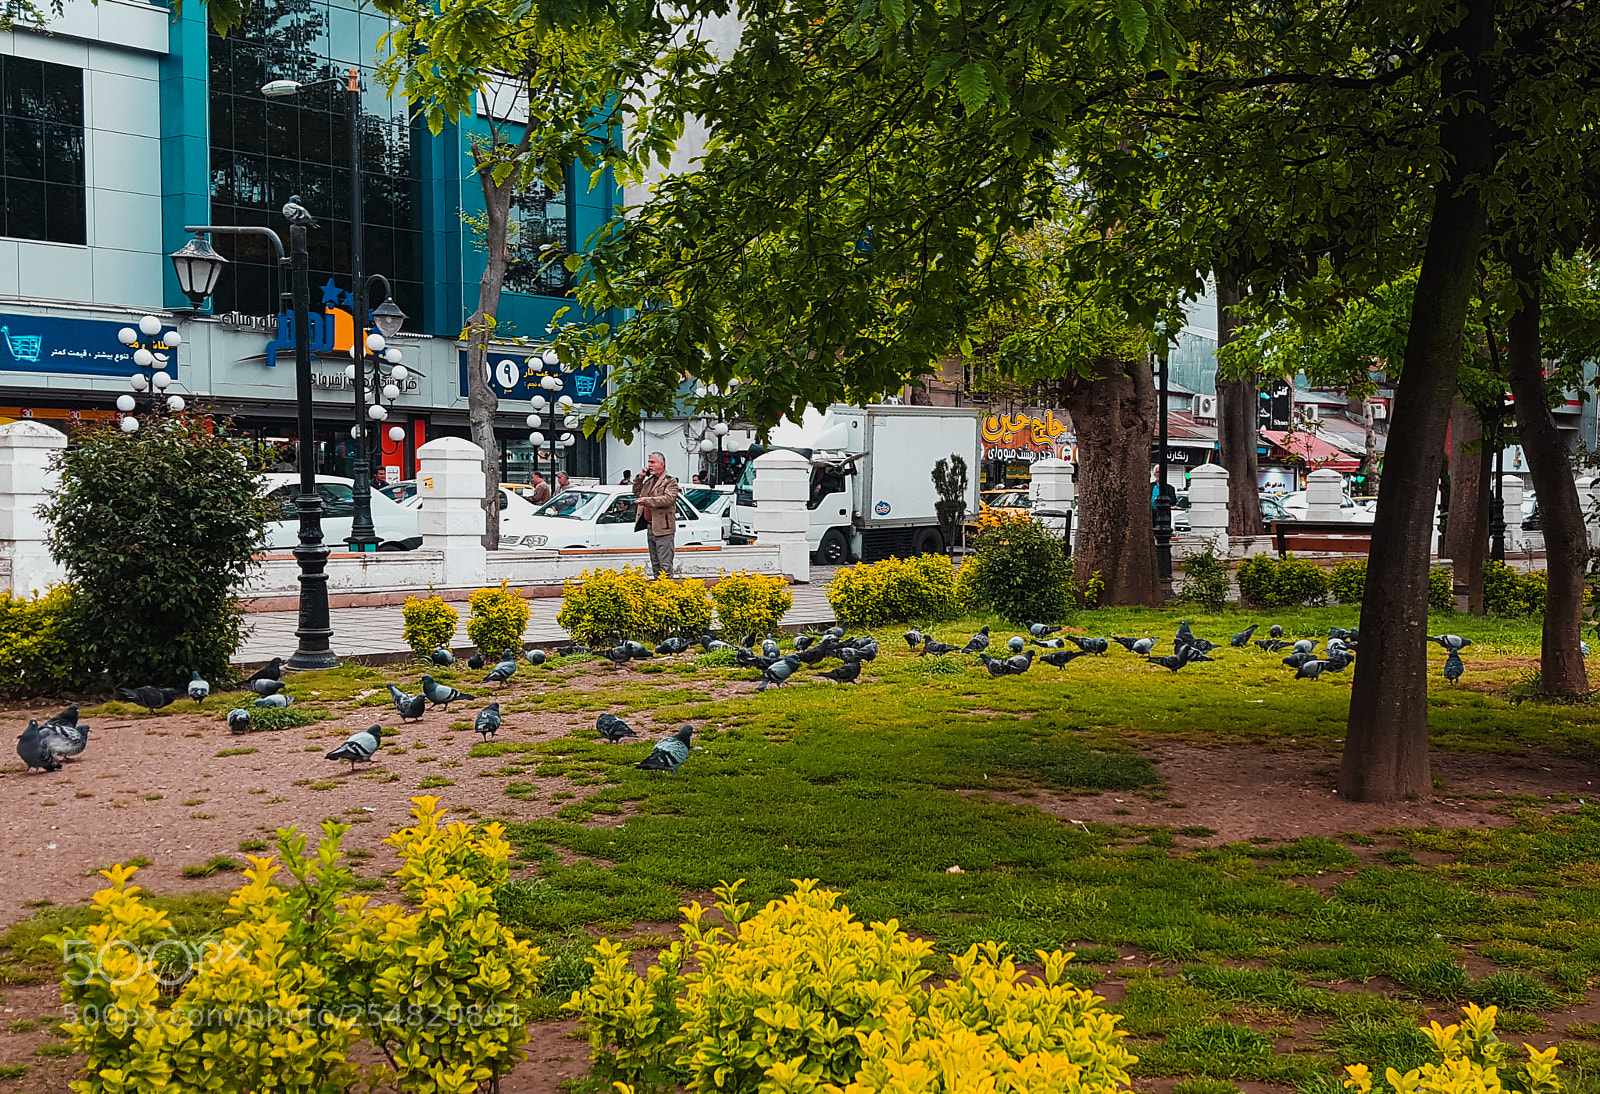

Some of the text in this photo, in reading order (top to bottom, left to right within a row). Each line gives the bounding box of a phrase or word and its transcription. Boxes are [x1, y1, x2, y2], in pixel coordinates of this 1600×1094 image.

[51, 348, 66, 356] کمتر
[67, 349, 87, 358] قیمت
[94, 351, 113, 360] بیشتر
[114, 353, 129, 362] تنوع
[1167, 450, 1189, 463] رنگارن
